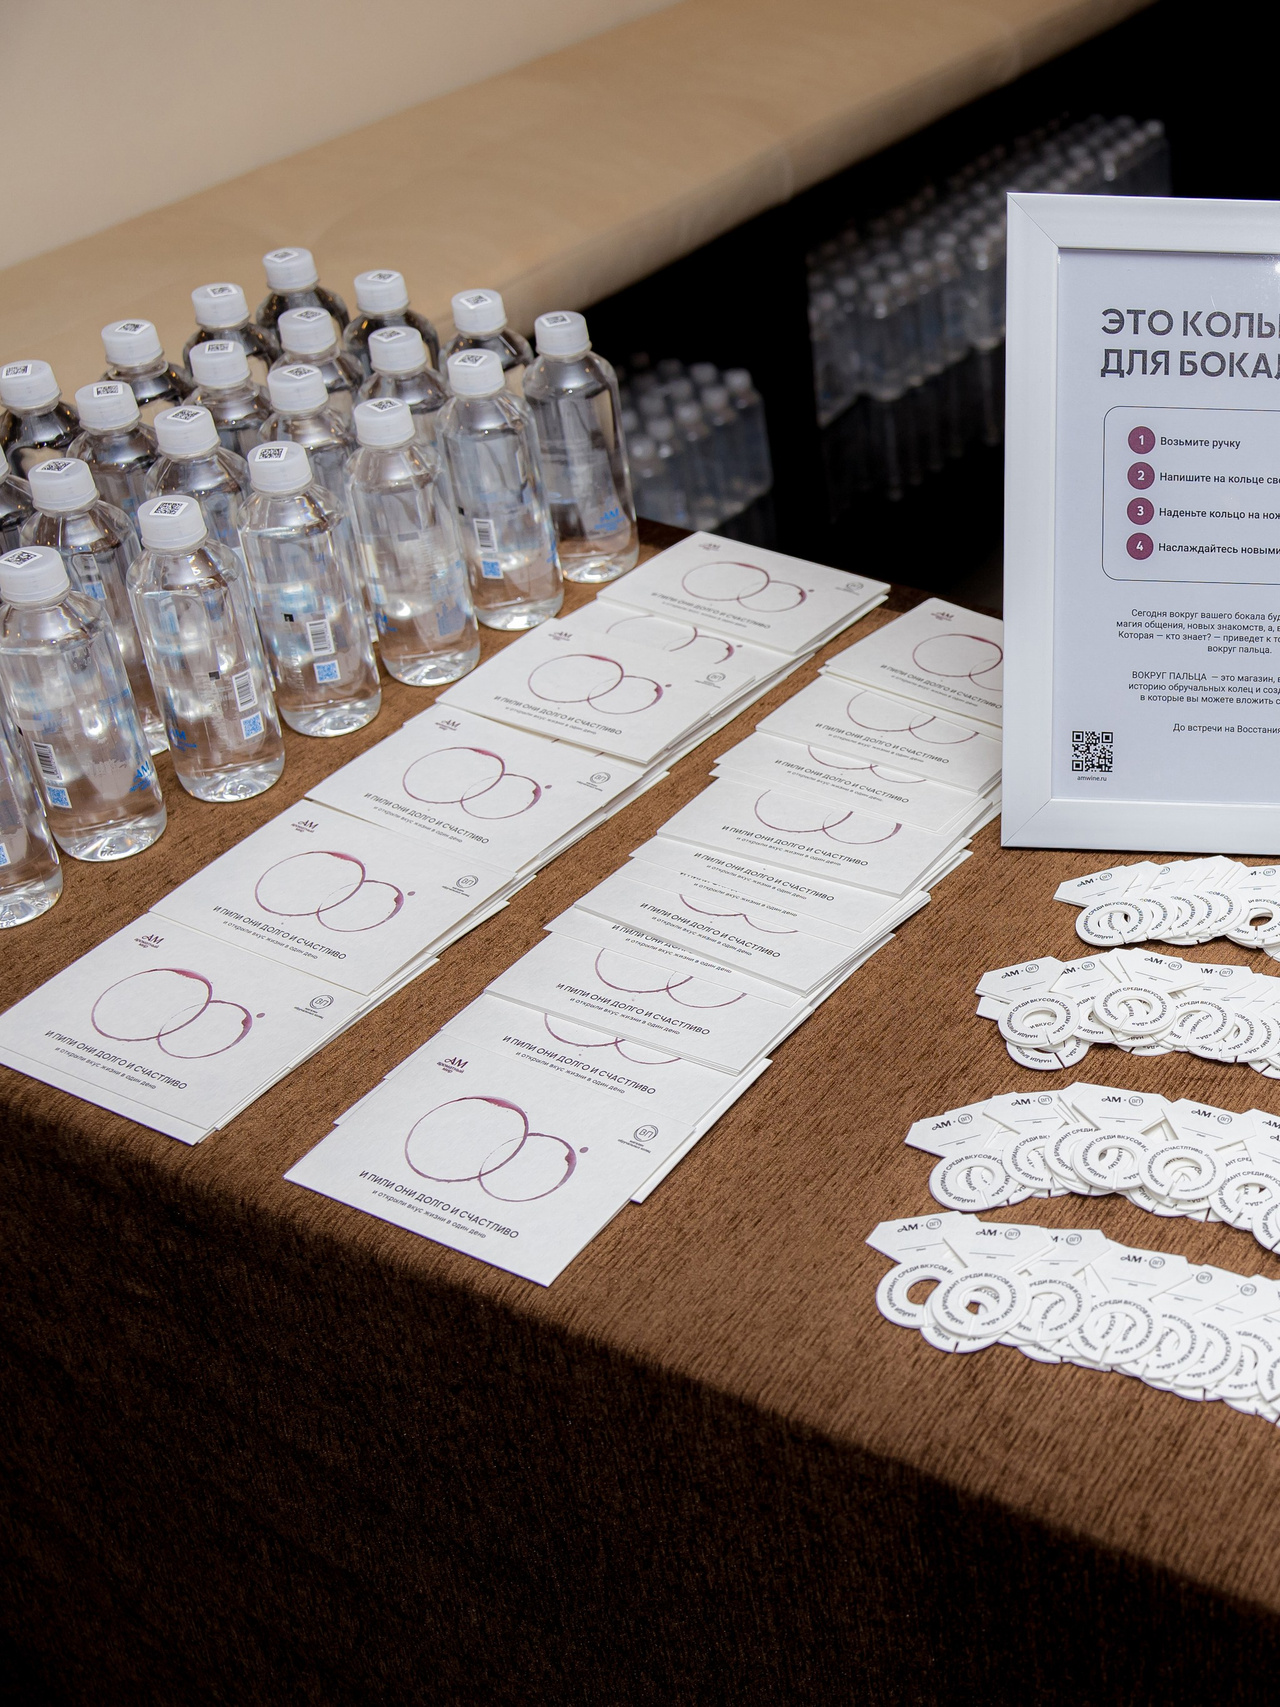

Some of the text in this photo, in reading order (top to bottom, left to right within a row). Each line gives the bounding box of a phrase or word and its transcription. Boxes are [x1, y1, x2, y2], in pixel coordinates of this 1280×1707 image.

[1101, 308, 1174, 336] ЭТО
[1100, 348, 1170, 378] ДЛЯ
[1138, 435, 1241, 450] 1 Возьмите ручку
[1137, 470, 1146, 482] 2
[1159, 472, 1211, 483] Напишите
[1213, 475, 1226, 483] на
[1228, 476, 1265, 486] кольце
[1137, 506, 1145, 518] 3
[1159, 507, 1207, 519] Наденьте
[1209, 510, 1246, 520] кольцо
[1135, 541, 1145, 553] 4
[1158, 542, 1239, 554] Наслаждайтесь
[1131, 608, 1167, 619] Сегодня
[1169, 611, 1199, 621] вокруг
[1200, 612, 1233, 620] вашего
[1234, 611, 1266, 621] бокала
[1144, 620, 1186, 631] общения,
[1217, 623, 1266, 632] знакомств,
[1267, 625, 1275, 633] а,
[1118, 630, 1154, 641] Которая
[1165, 633, 1181, 641] кто
[1182, 632, 1212, 641] знает?
[1223, 635, 1264, 644] приведет
[1207, 645, 1272, 655] вокруг пальца.
[1131, 670, 1167, 680] ВОКРУГ
[1169, 671, 1207, 681] ПАЛЬЦА
[1237, 675, 1276, 684] магазин,
[1128, 683, 1167, 692] историю
[1167, 682, 1226, 694] обручальных
[1227, 686, 1254, 695] колец
[1147, 694, 1185, 704] которые
[1201, 696, 1234, 704] можете
[1236, 697, 1274, 705] вложить
[1172, 723, 1186, 733] До
[1187, 725, 1223, 734] встречи
[729, 827, 754, 837] ПИЛИ
[754, 833, 775, 842] ОНИ
[773, 838, 806, 850] ДОЛГО
[814, 849, 869, 866] СЧАСТЛИВО
[219, 908, 244, 921] ПИЛИ
[242, 917, 263, 928] ОНИ
[258, 924, 291, 939] ДОЛГО
[288, 934, 298, 942] И
[296, 937, 347, 960] СЧАСТЛИВО
[51, 1033, 79, 1047] ПИЛИ
[76, 1042, 98, 1054] ОНИ
[93, 1050, 128, 1066] ДОЛГО
[125, 1062, 136, 1070] И
[133, 1065, 188, 1090] СЧАСТЛИВО
[503, 1035, 512, 1043] И
[510, 1038, 538, 1052] ПИЛИ
[536, 1047, 559, 1059] ОНИ
[555, 1055, 591, 1071] ДОЛГО
[598, 1070, 656, 1095] СЧАСТЛИВО
[359, 1170, 519, 1239] И ПИЛИ ОНИ ДОЛГО И СЧАСТЛИВО
[377, 1192, 408, 1207] открыли
[406, 1203, 424, 1214] вкус
[423, 1210, 447, 1223] жизни
[451, 1221, 470, 1232] один
[468, 1228, 487, 1239] день
[960, 1273, 983, 1282] СРЕДИ
[984, 1272, 1009, 1286] ВКУСОВ
[942, 1280, 960, 1309] БРИЛЛИАНТ
[945, 1307, 965, 1325] НАЙДИ
[1001, 1308, 1013, 1319] ЕМУ
[981, 1318, 1000, 1326] «ДА»
